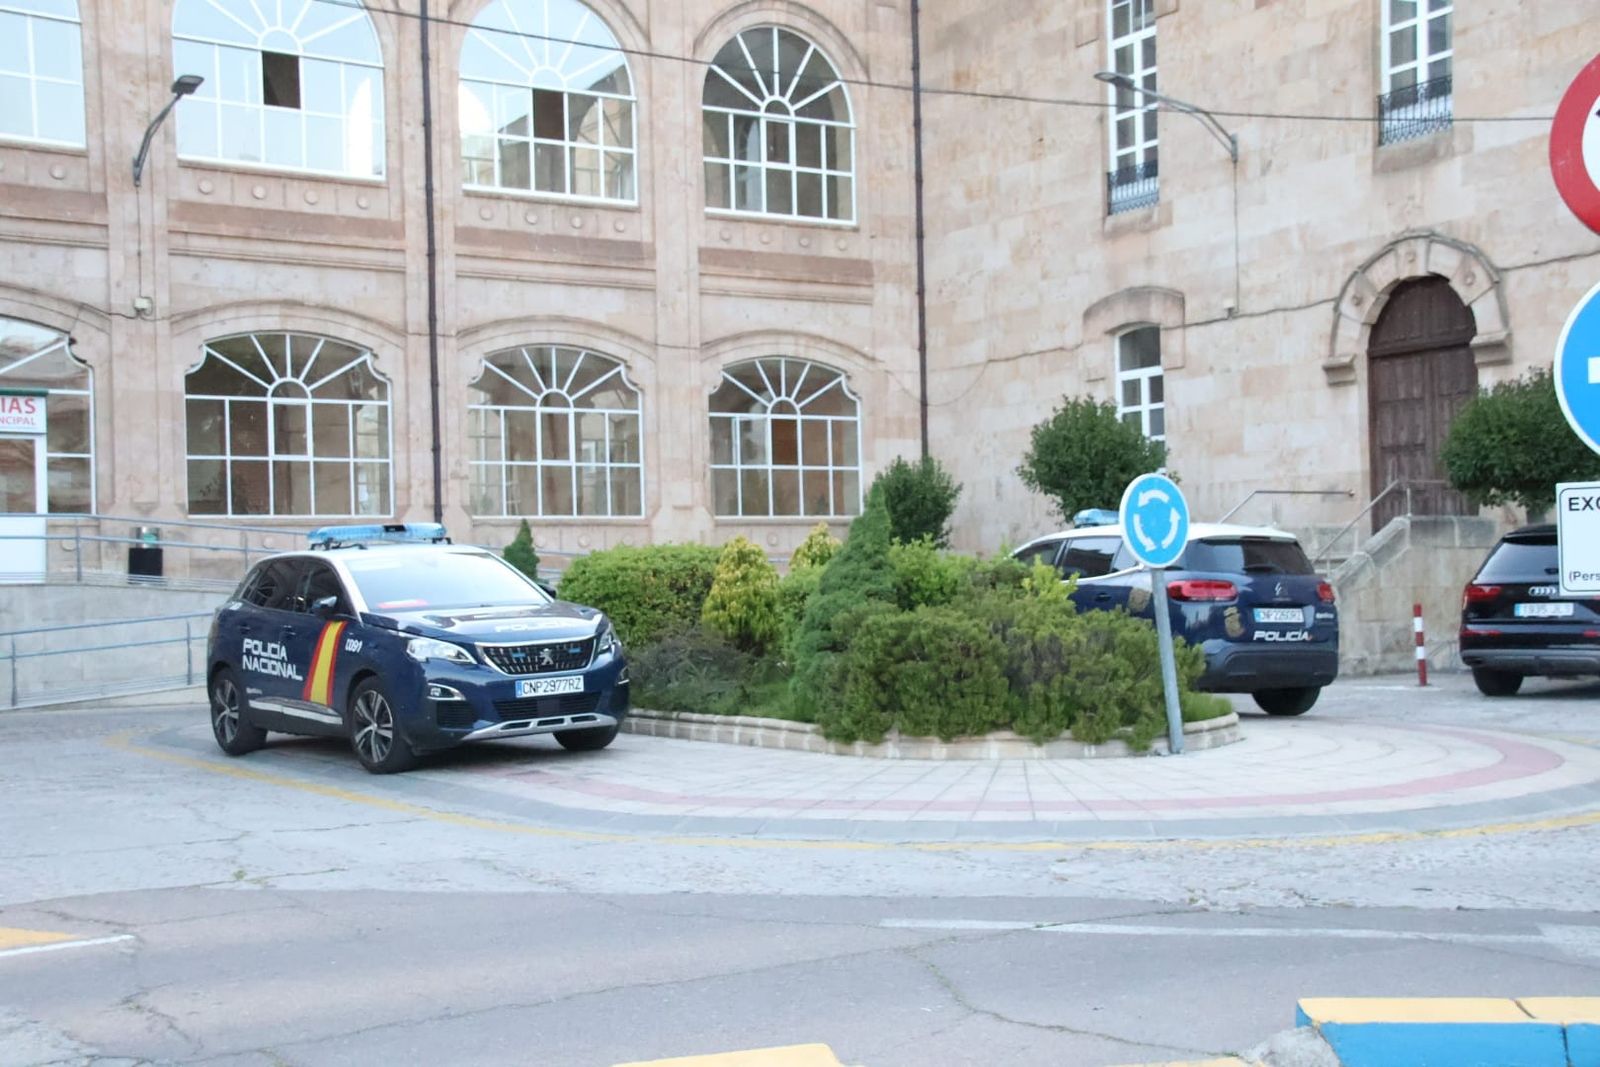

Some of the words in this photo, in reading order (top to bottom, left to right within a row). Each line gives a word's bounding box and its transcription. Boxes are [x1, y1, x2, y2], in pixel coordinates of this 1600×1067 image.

[1253, 629, 1309, 642] POLICÍA
[242, 638, 288, 661] POLICÍA
[242, 655, 303, 681] NACIONAL
[522, 677, 582, 695] CNP2977RZ
